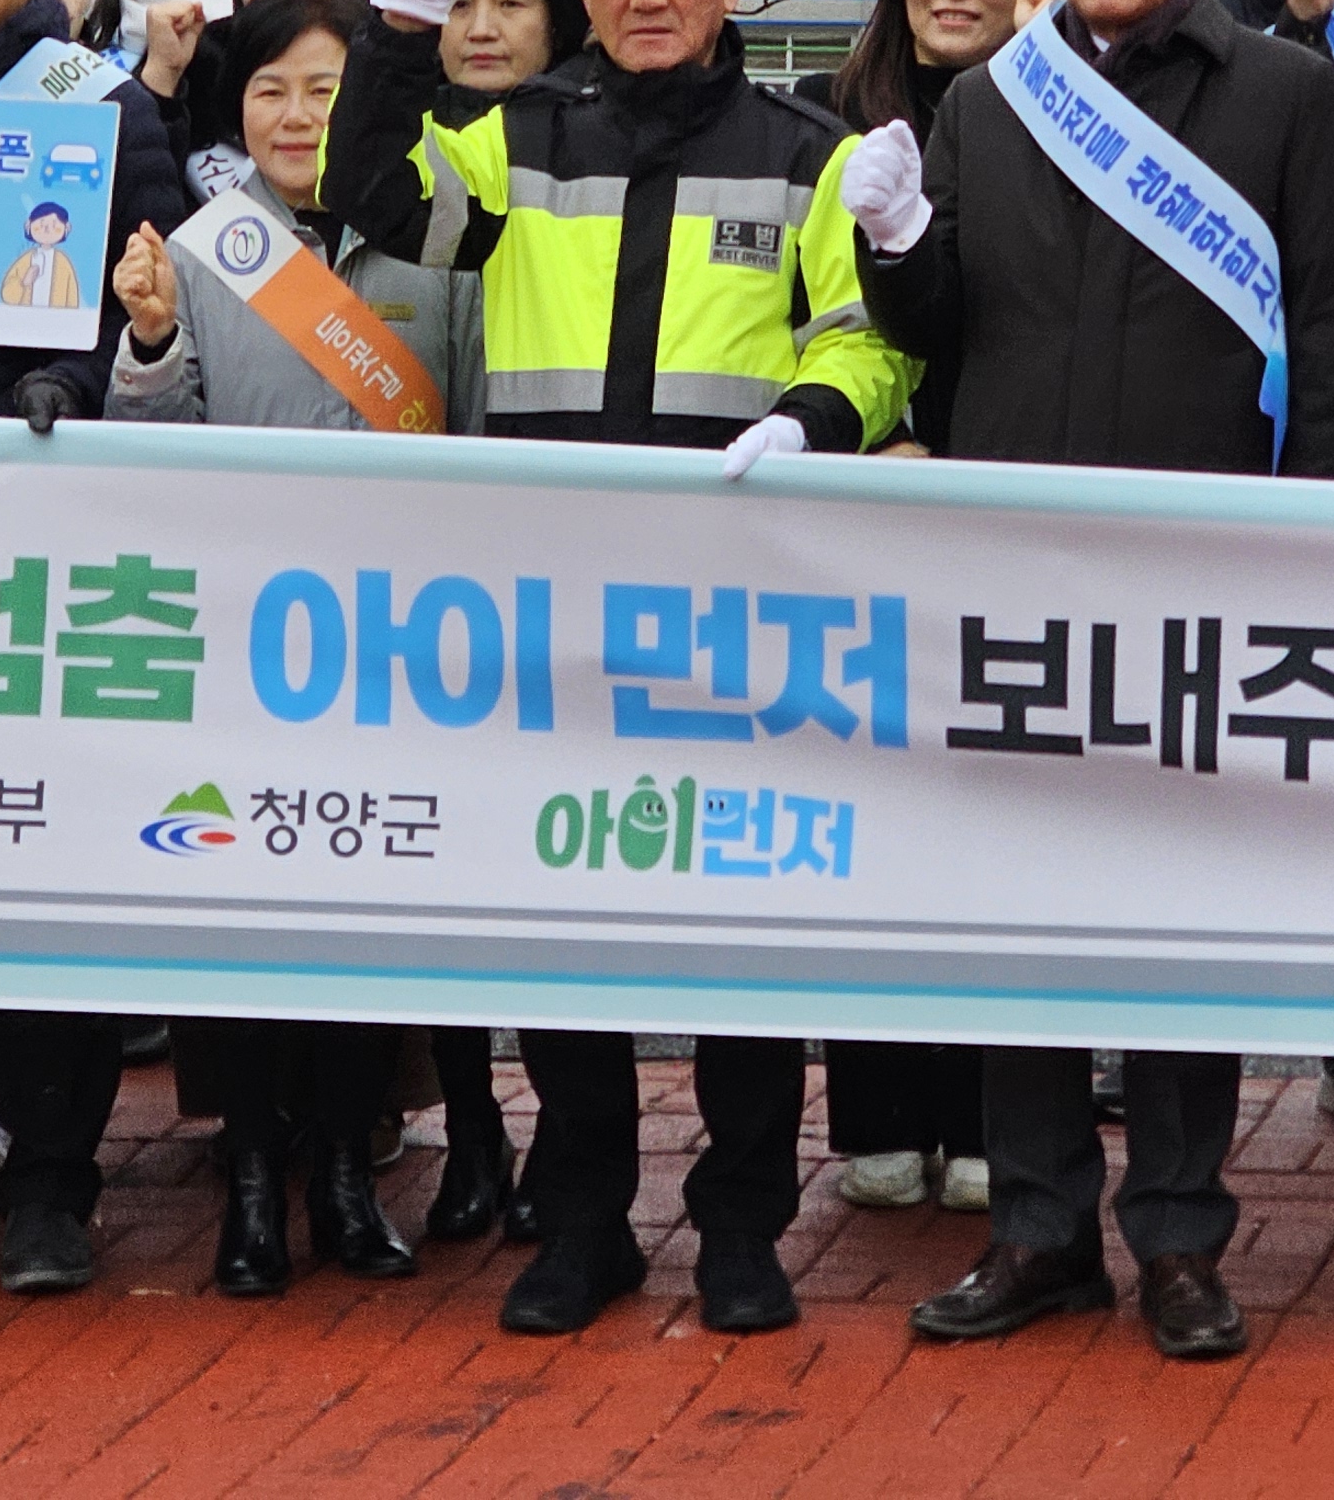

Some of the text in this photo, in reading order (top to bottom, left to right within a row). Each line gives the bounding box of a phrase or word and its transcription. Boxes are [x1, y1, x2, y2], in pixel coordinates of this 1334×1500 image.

[720, 222, 777, 251] 모범
[249, 567, 555, 732] 아이
[602, 582, 910, 750] 먼저
[249, 786, 441, 861] 청양군
